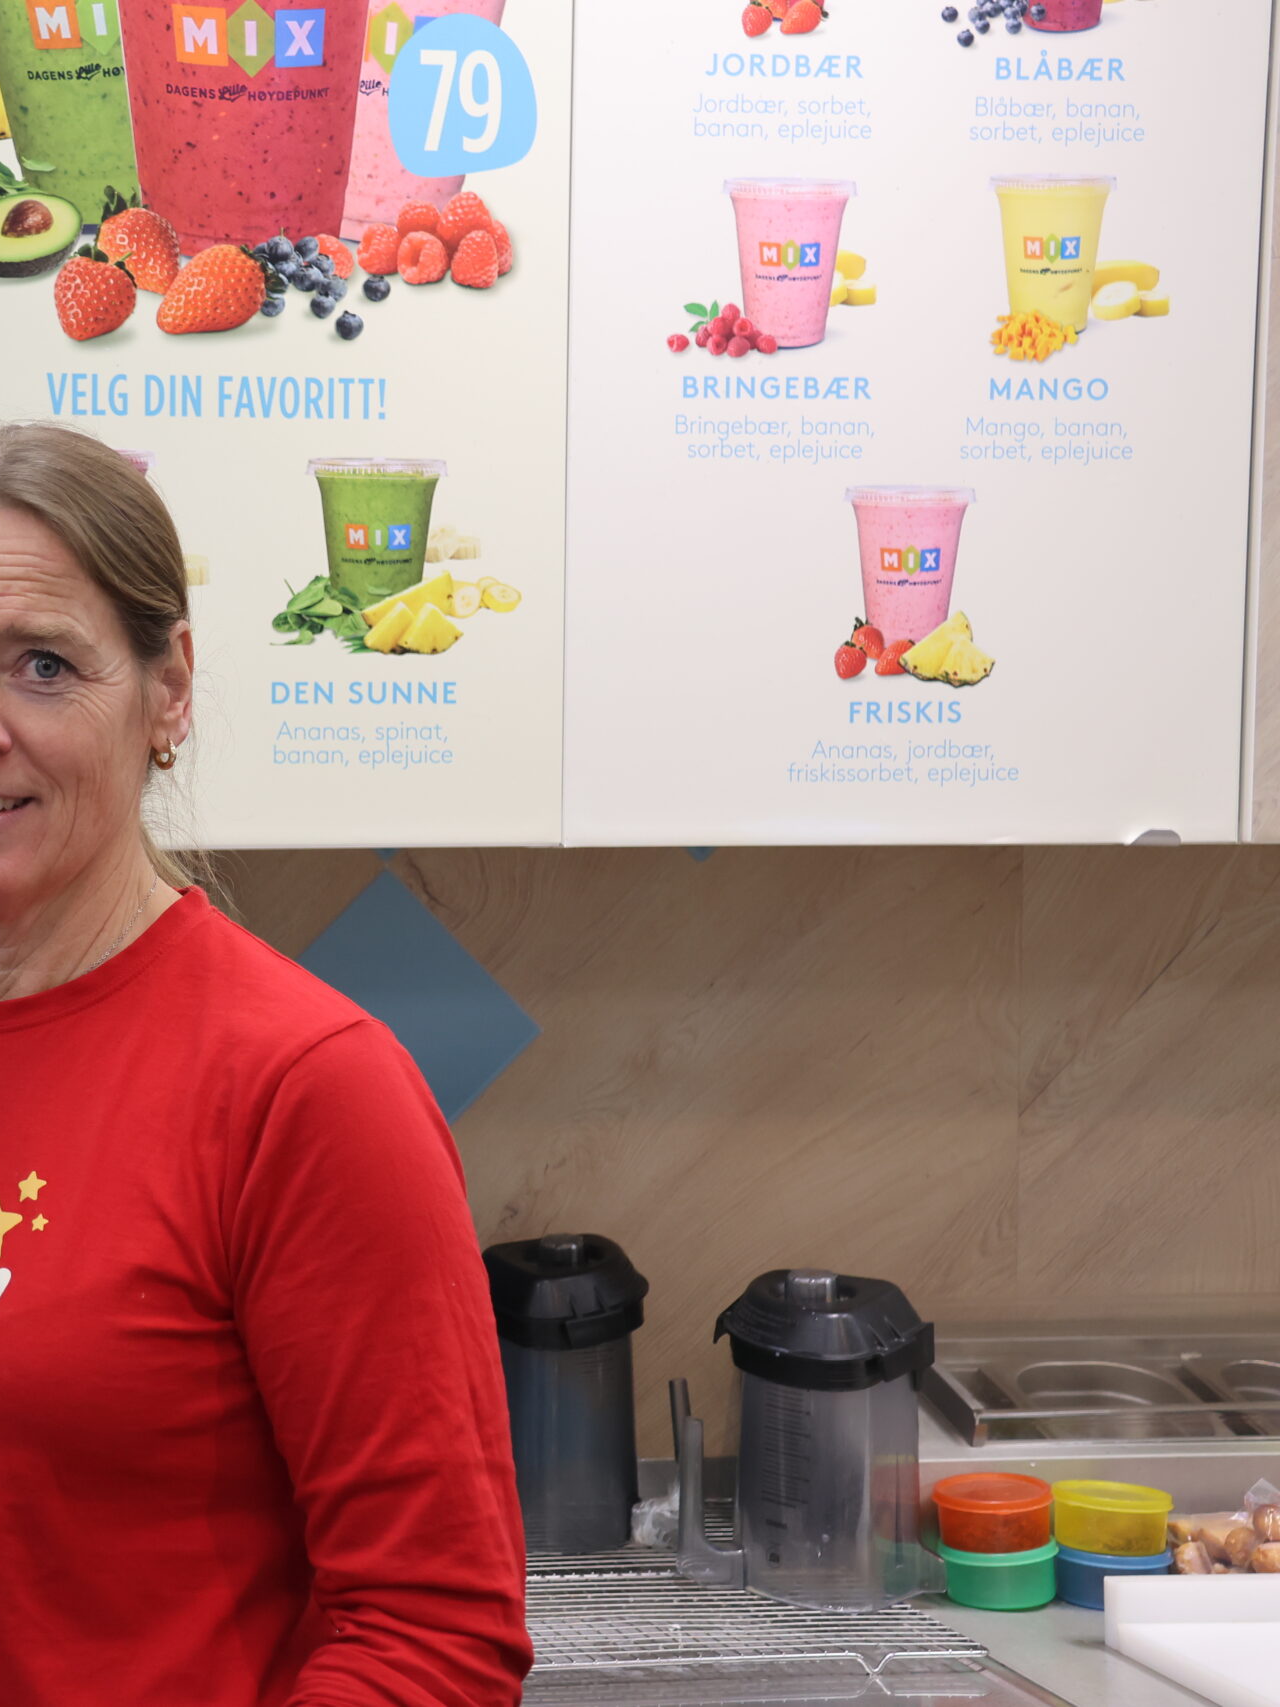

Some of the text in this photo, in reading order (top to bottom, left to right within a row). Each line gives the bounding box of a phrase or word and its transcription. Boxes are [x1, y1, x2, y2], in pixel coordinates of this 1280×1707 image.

[179, 11, 319, 61] MIX
[26, 69, 74, 81] DAGENS
[705, 52, 864, 79] JORDBÆR
[994, 48, 1126, 82] BLÅBÆR
[165, 83, 216, 100] DAGENS
[247, 87, 330, 102] HØYDEPUNKT
[418, 49, 504, 154] 79
[692, 93, 872, 119] Jordbær, sorbet,
[974, 96, 1141, 121] Blåbær, banan,
[692, 118, 873, 145] banan, eplejuice
[969, 121, 1145, 147] sorbet, eplejuice
[761, 245, 818, 265] MIX
[1025, 238, 1079, 258] MIX
[47, 372, 386, 420] VELG DIN FAVORITT!
[682, 375, 872, 401] BRINGEBÆR
[989, 377, 1109, 401] MANGO
[674, 414, 876, 441] Bringebær, banan,
[965, 416, 1128, 442] Mango, banan,
[687, 438, 864, 465] sorbet, eplejuice
[959, 439, 1134, 466] sorbet, eplejuice
[347, 526, 408, 548] MIX
[882, 550, 938, 570] MIX
[271, 681, 458, 705] DEN SUNNE
[849, 700, 963, 724] FRISKIS
[276, 721, 449, 748] Ananas, spinat,
[272, 744, 454, 770] banan, eplejuice
[810, 739, 995, 764] Ananas, jordbær,
[786, 762, 1020, 787] friskissorbet, eplejuice
